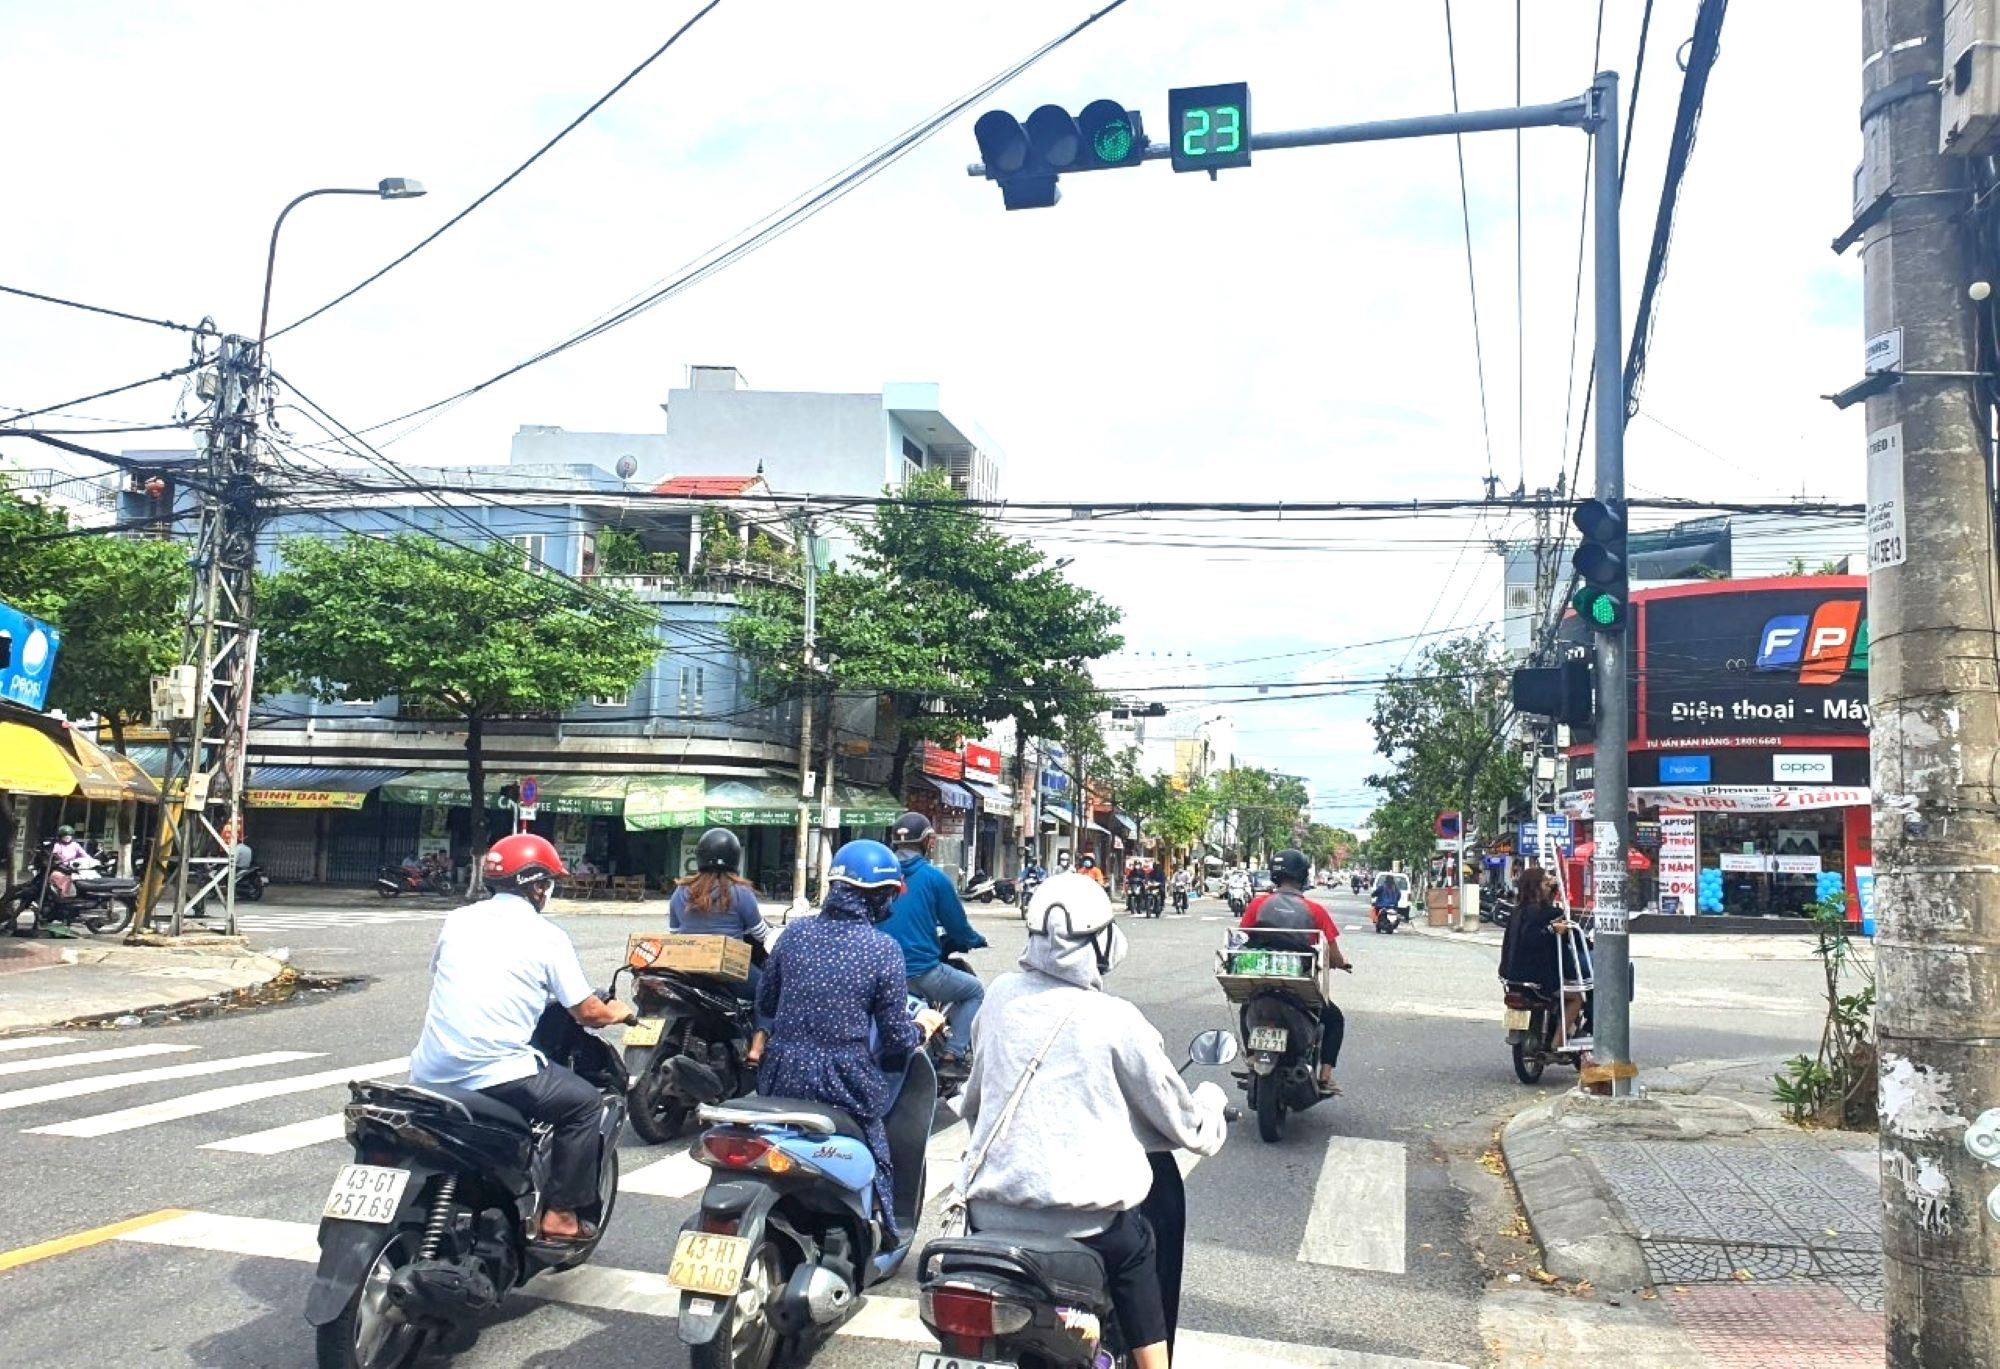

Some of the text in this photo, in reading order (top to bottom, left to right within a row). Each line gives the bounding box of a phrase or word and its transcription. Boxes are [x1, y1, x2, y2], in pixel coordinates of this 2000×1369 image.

[1183, 106, 1240, 155] 23
[1671, 700, 1724, 725] Điện
[1731, 698, 1795, 723] thoại
[1776, 793, 1791, 807] 2
[1660, 818, 1694, 826] APTOP
[1671, 882, 1695, 895] 0%
